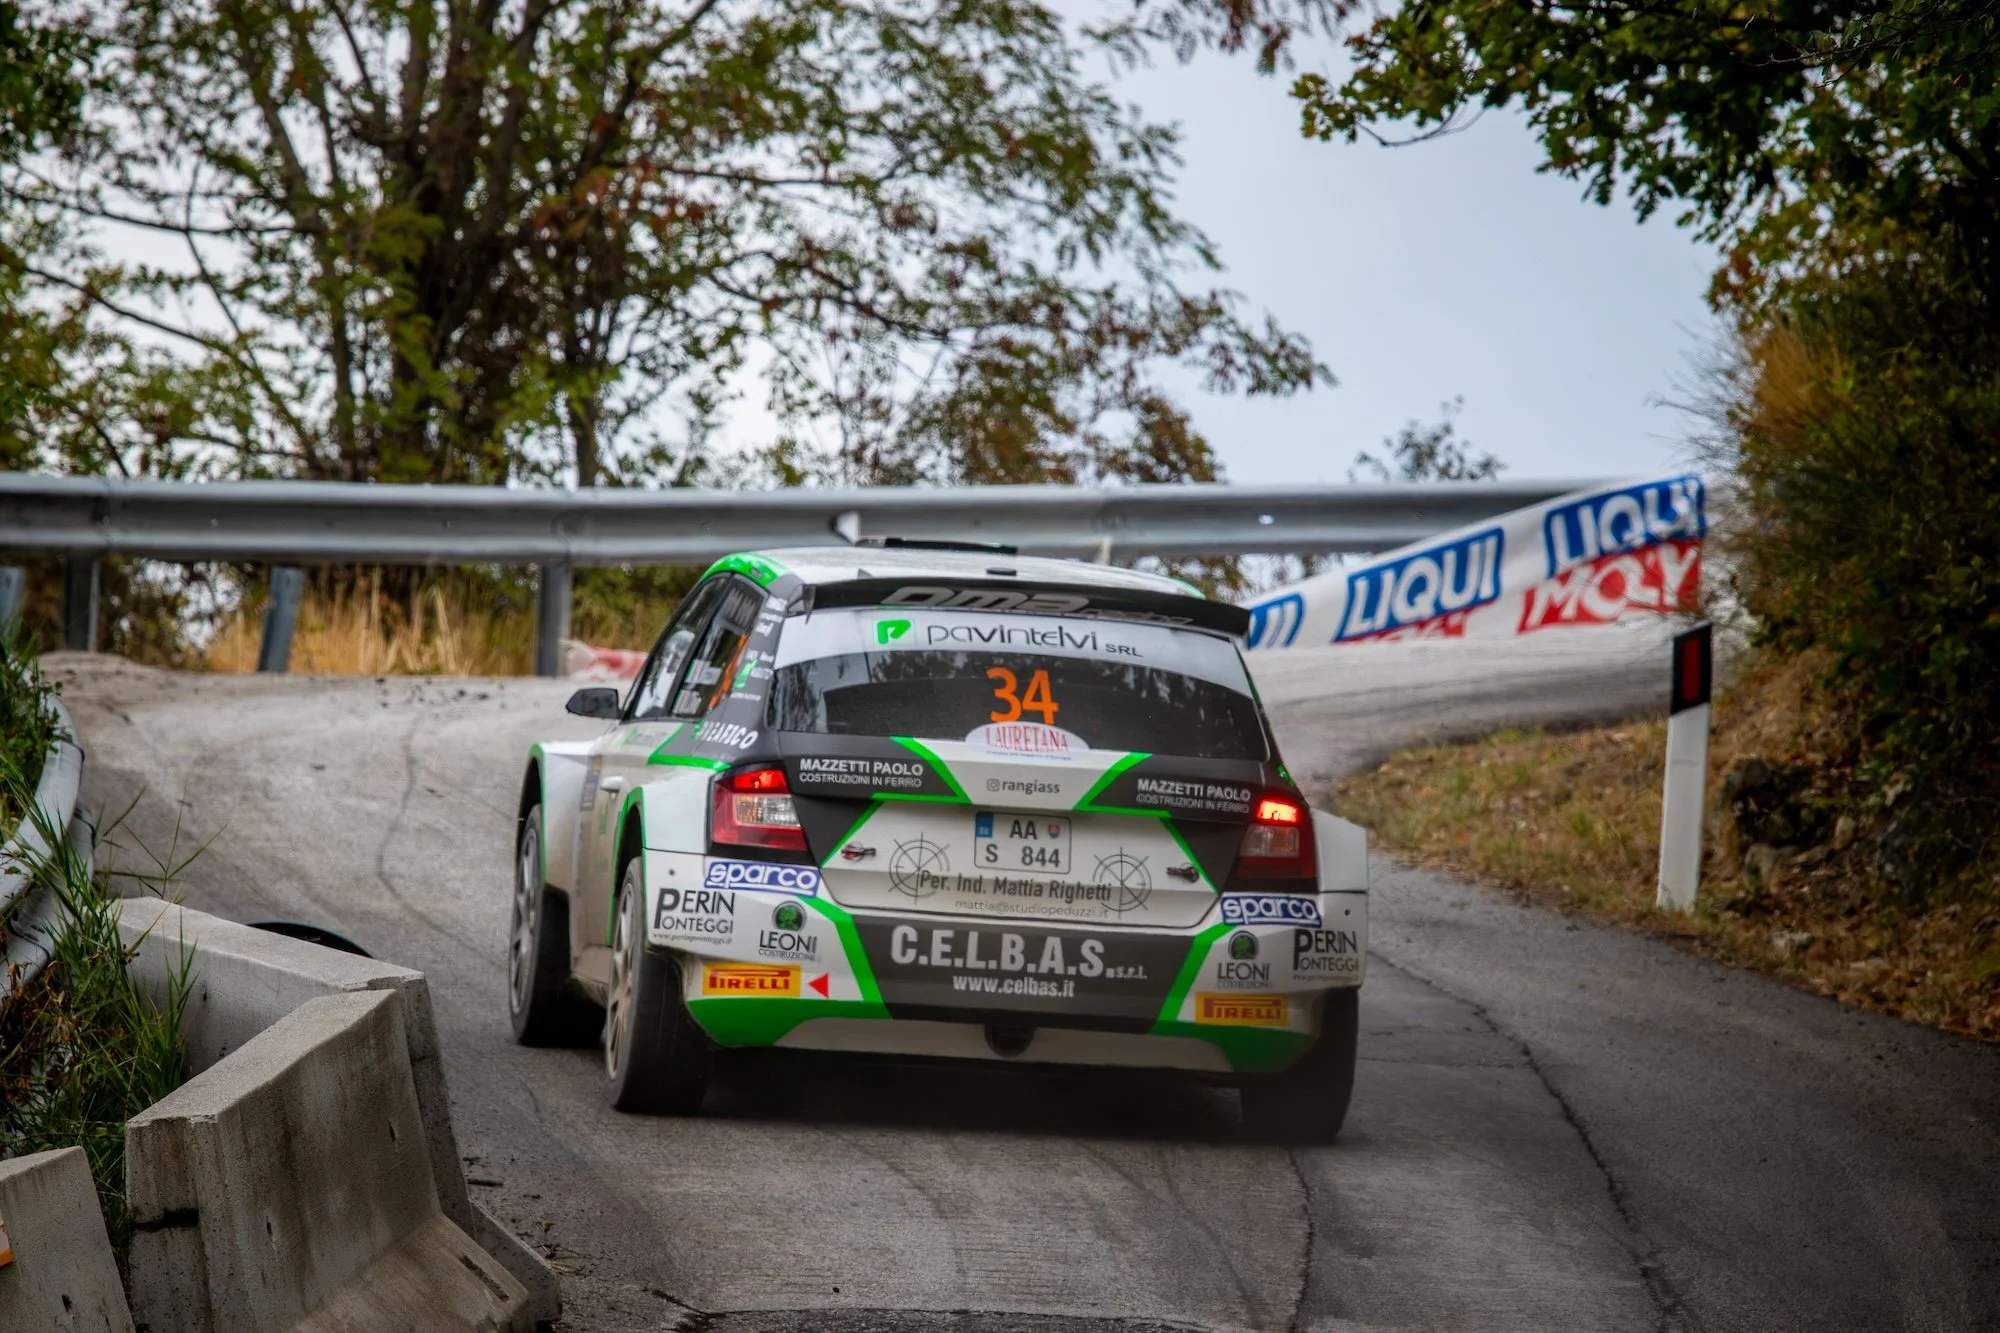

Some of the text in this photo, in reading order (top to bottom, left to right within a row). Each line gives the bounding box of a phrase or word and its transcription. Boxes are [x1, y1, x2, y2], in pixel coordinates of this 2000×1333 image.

[1343, 538, 1496, 637] LIQUI
[1527, 543, 1699, 627] MOLY
[927, 624, 1098, 651] pavintelvi
[1105, 643, 1144, 657] SRL
[986, 667, 1059, 726] 34
[985, 726, 1069, 752] LAURETANA
[800, 758, 923, 776] MAZZETTI PAOLO
[799, 772, 922, 788] COSTRUZIONI IN FERRO
[1137, 779, 1251, 802] MAZZETTI PAOLO
[1136, 793, 1250, 814] COSTRUZIONI IN FERRO
[1009, 819, 1037, 840] AA
[985, 843, 1061, 868] S 844
[709, 863, 818, 890] sparco
[920, 870, 1112, 904] Per. Ind. Mattia Righetti
[1222, 897, 1319, 924] sparco
[759, 929, 818, 954] LEONI
[709, 968, 792, 990] PIRELLI
[1218, 962, 1270, 981] LEONI
[952, 975, 1076, 998] www.celbas.it
[1203, 997, 1281, 1020] PIRELLI
